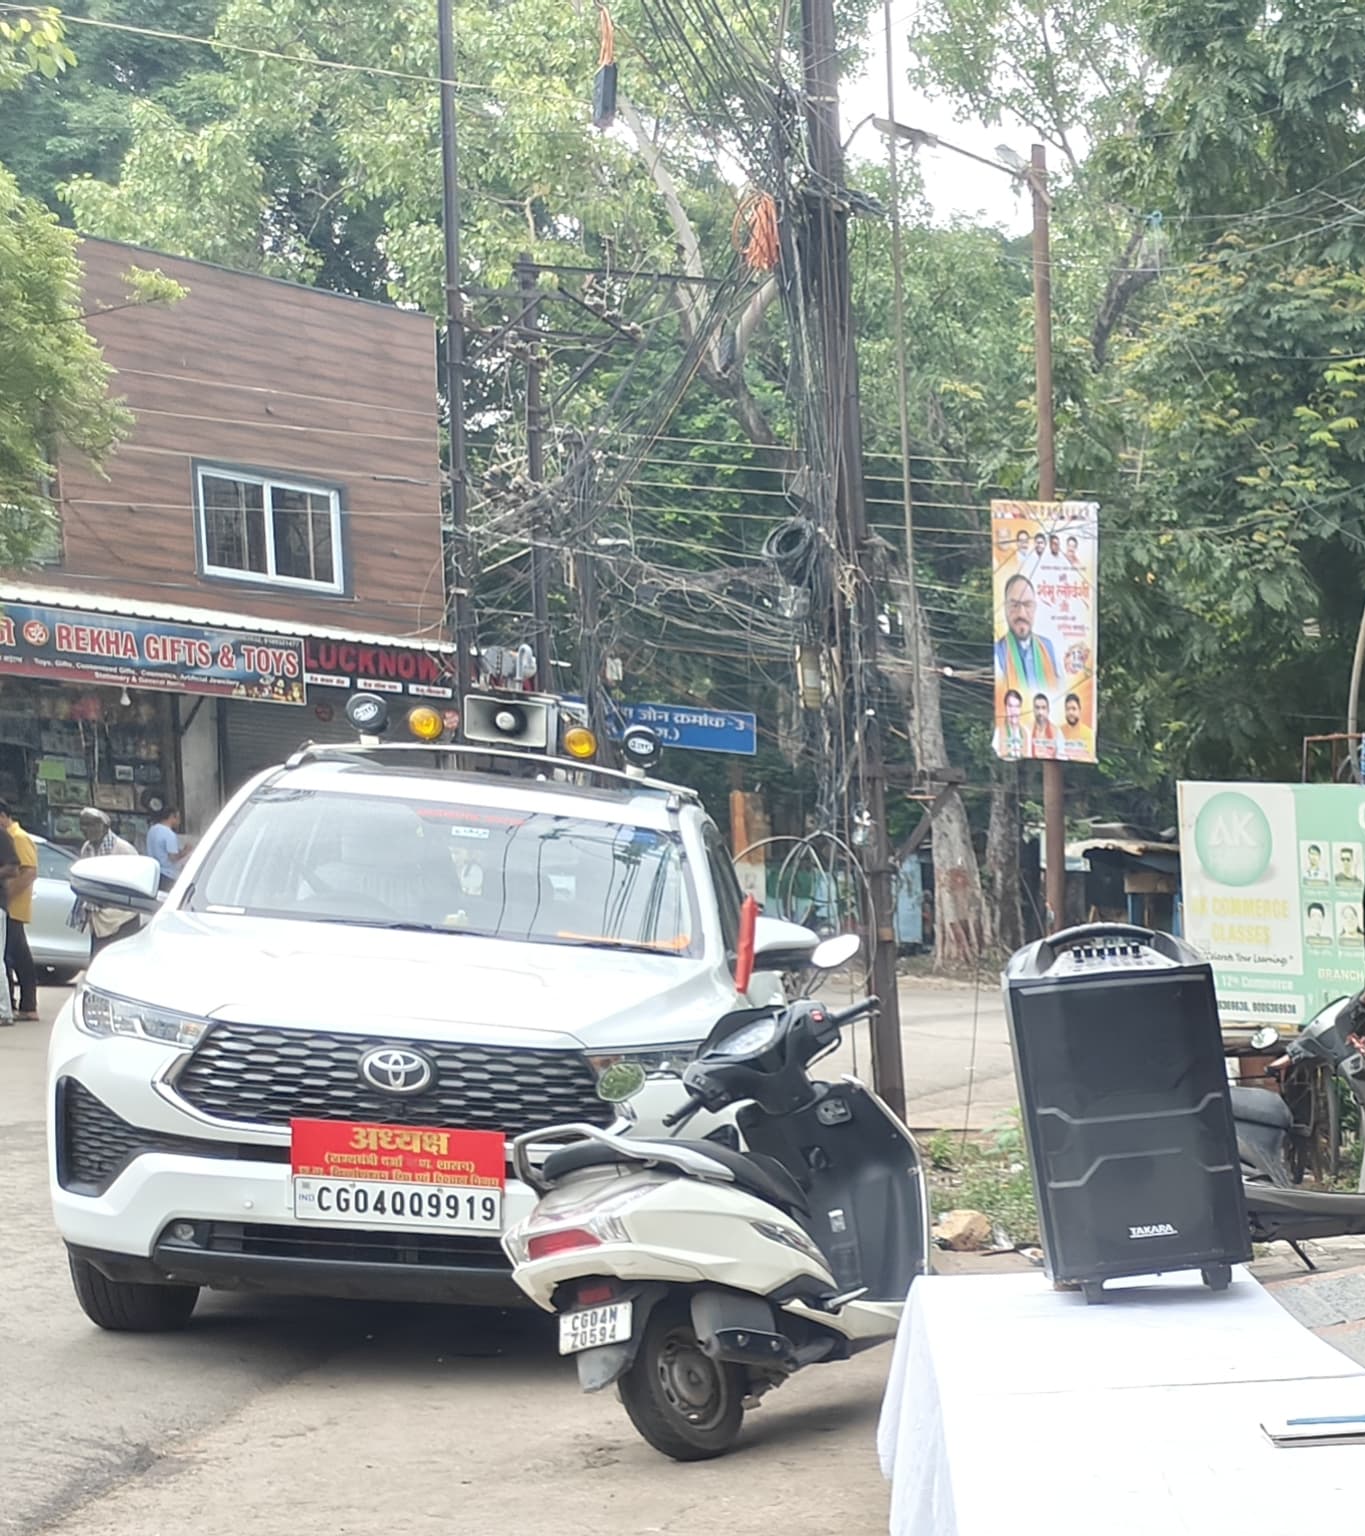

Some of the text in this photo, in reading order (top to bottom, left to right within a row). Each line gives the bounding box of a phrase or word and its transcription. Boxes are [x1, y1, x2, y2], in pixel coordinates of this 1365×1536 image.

[55, 622, 139, 661] REKHA
[144, 633, 211, 669] GIFTS
[217, 643, 236, 671] &
[241, 645, 301, 678] TOYS
[1207, 811, 1257, 848] AK
[349, 1125, 451, 1156] अध्यक्ष
[316, 1185, 497, 1223] CG04QQ9919
[1128, 1223, 1176, 1237] TAKARA
